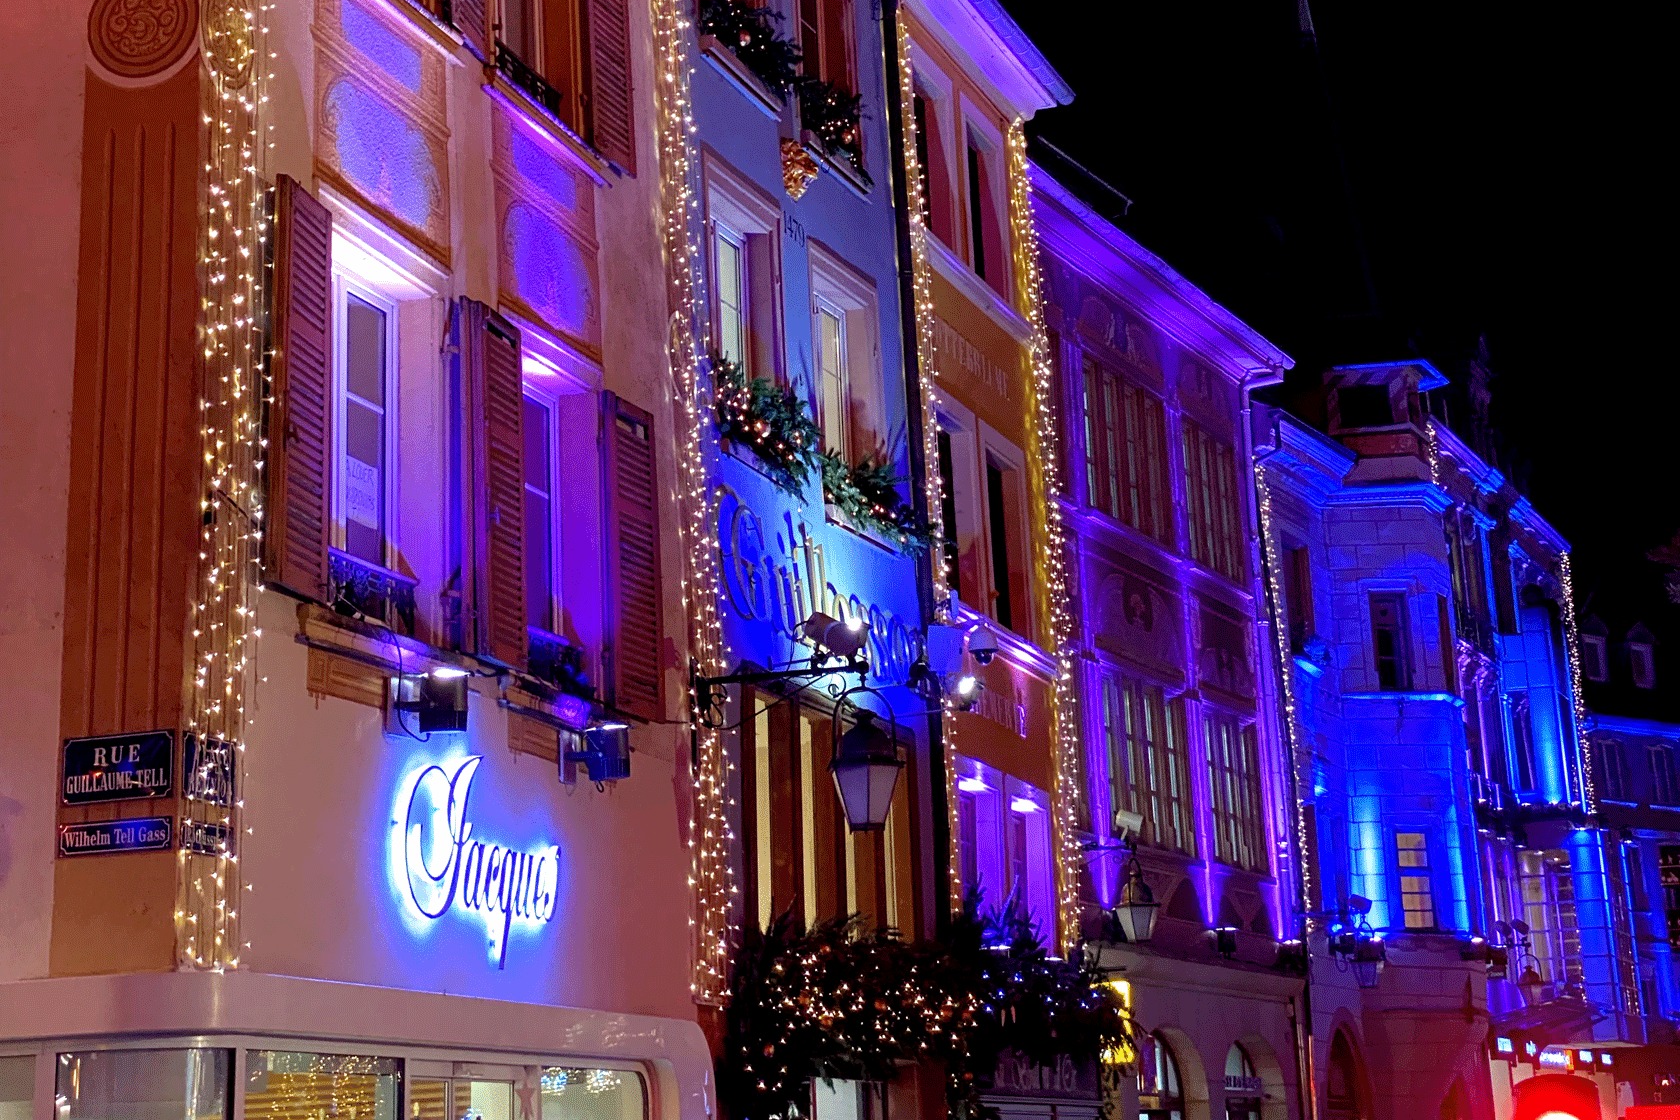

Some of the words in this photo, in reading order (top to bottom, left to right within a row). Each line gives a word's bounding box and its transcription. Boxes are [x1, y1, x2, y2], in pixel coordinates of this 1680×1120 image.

[783, 210, 805, 248] 1470
[93, 744, 141, 767] RUE
[66, 770, 133, 794] GUILLAUME
[135, 767, 168, 788] TELL
[64, 829, 111, 848] Wilhelm
[114, 827, 135, 844] Tell
[138, 826, 166, 842] Gass
[405, 755, 561, 970] Jacques
